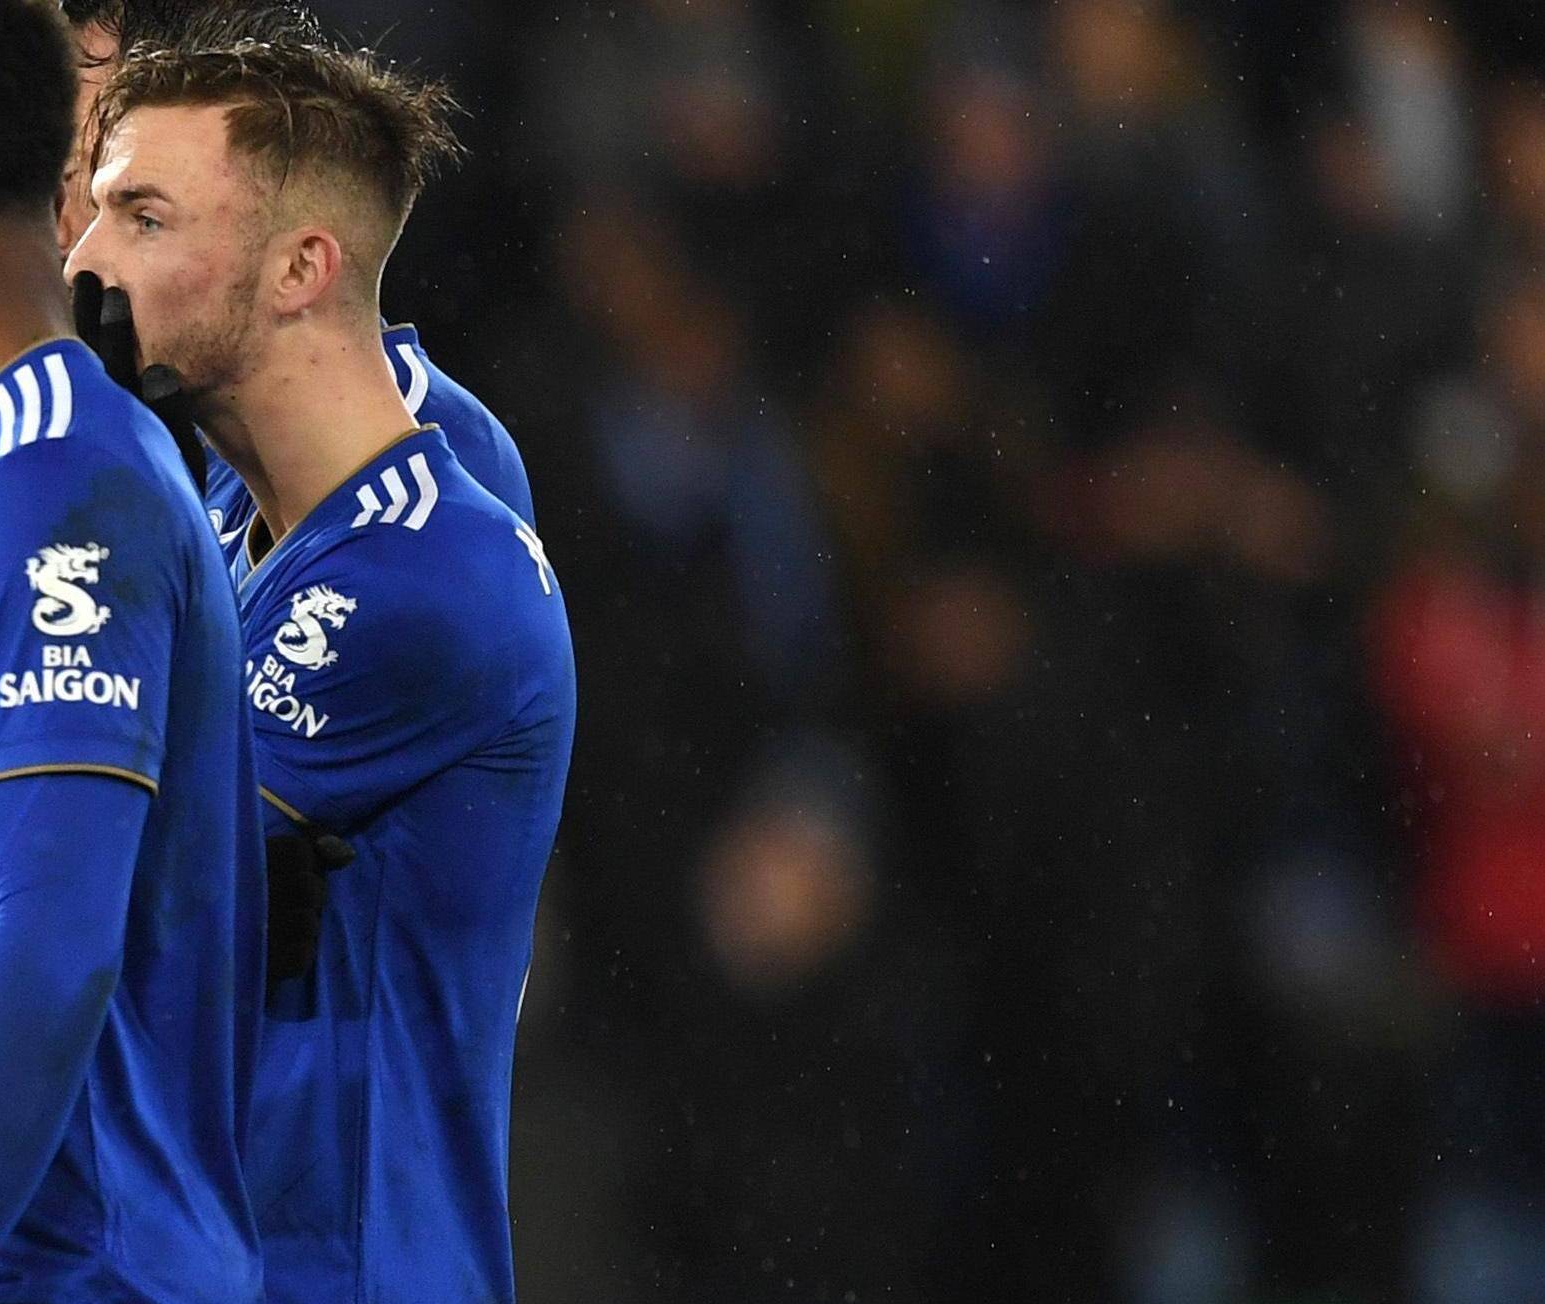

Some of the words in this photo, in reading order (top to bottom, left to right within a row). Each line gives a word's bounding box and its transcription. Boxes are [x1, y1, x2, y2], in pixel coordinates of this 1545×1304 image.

[42, 645, 93, 668] BIA
[261, 654, 296, 693] BIA
[245, 660, 330, 738] IGON
